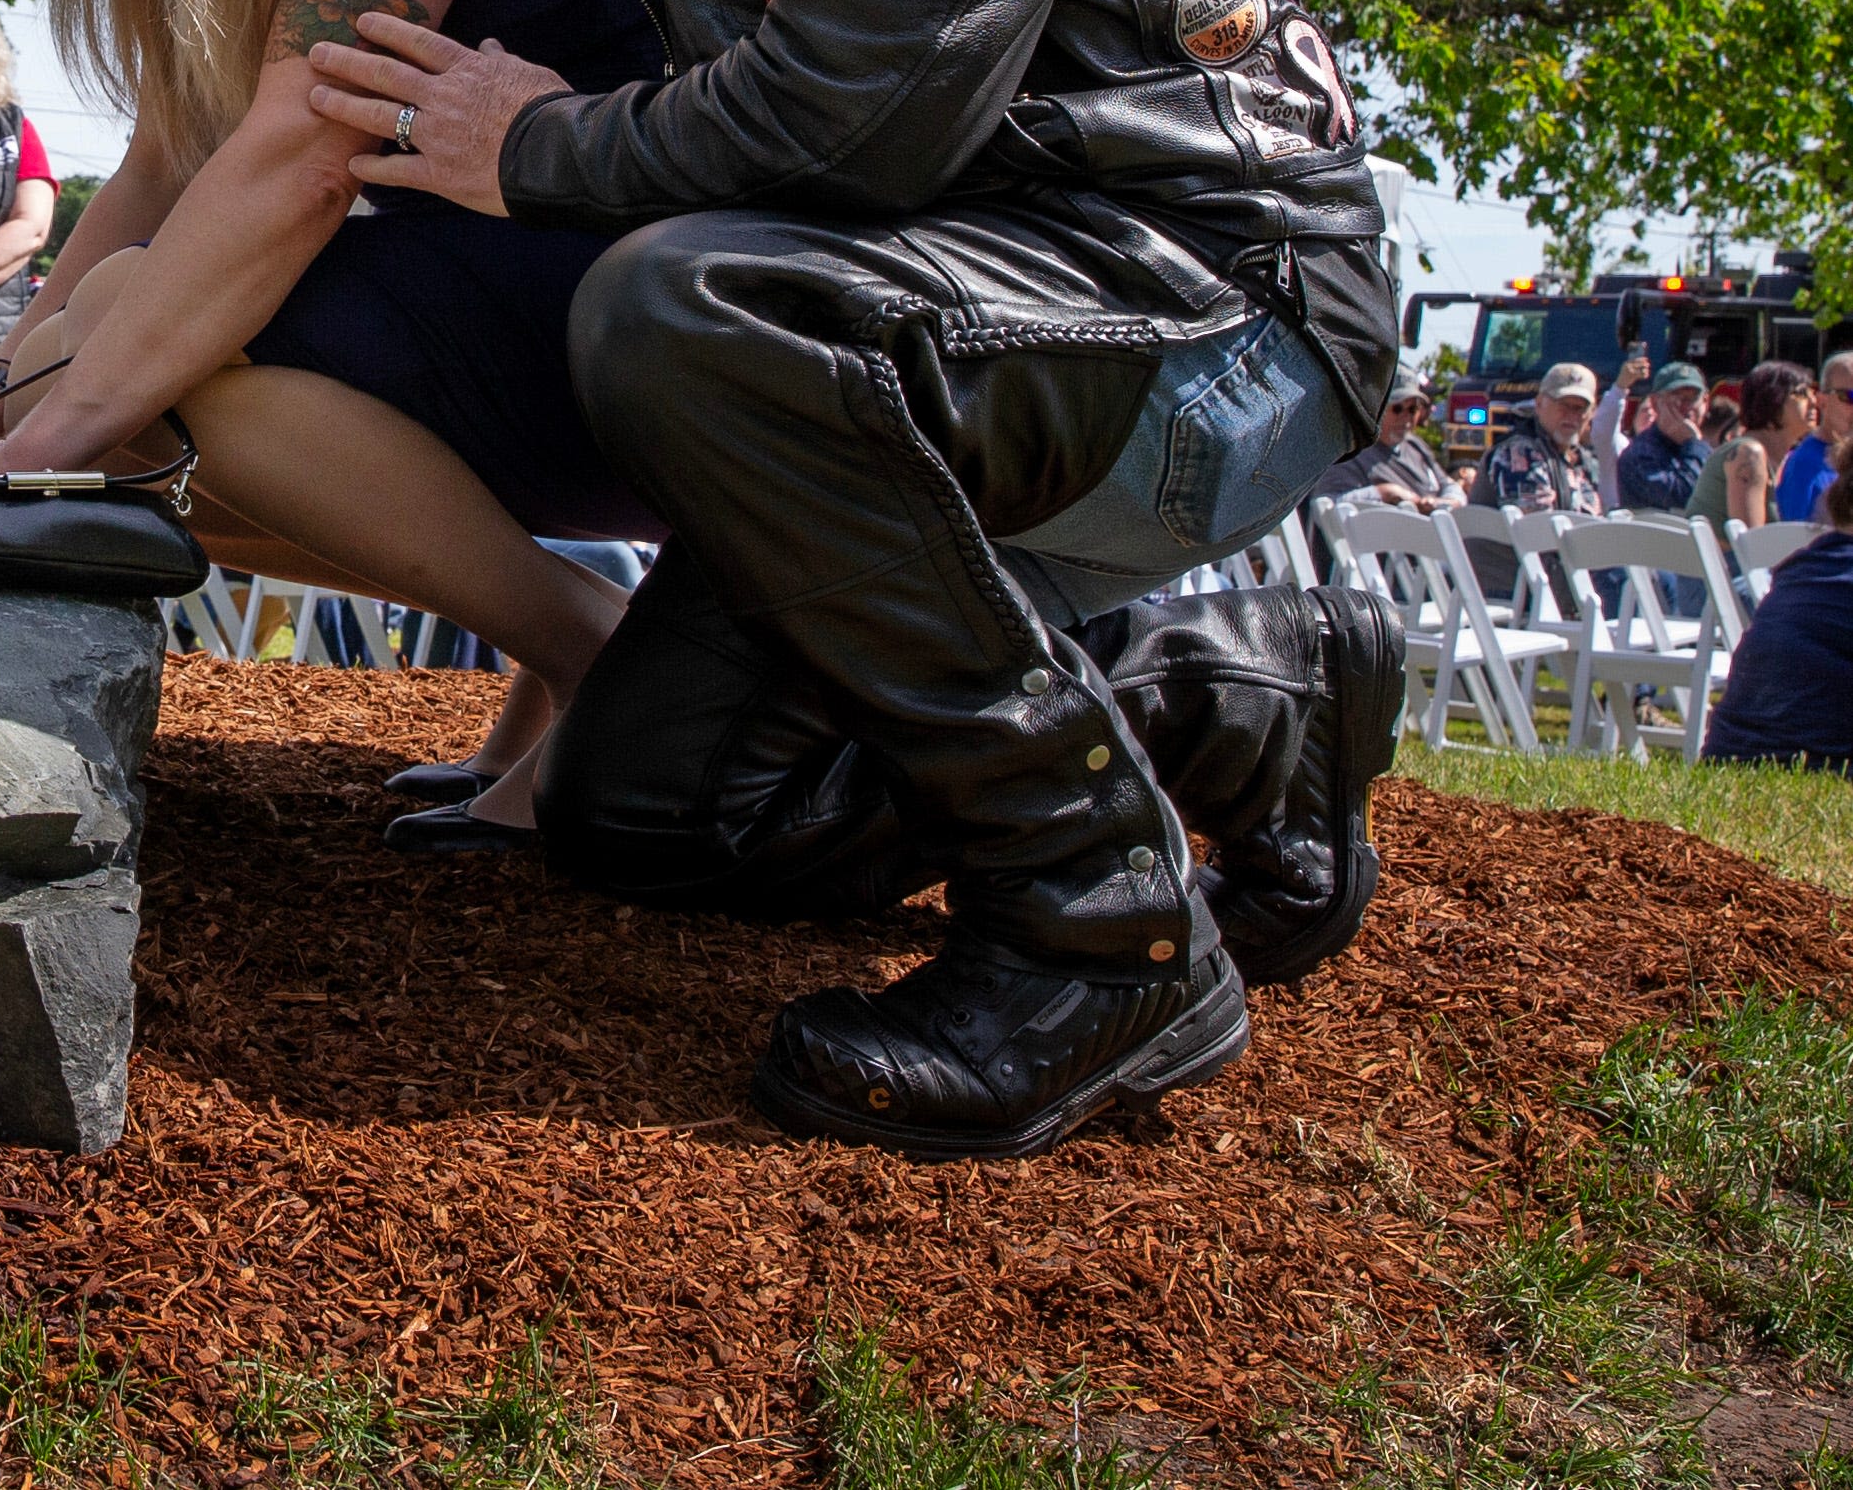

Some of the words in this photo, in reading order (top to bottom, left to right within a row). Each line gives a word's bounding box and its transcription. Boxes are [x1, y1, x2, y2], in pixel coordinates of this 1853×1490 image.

[1189, 38, 1221, 58] CURVES
[1223, 46, 1234, 56] IN
[1241, 11, 1254, 41] MILES
[1212, 19, 1239, 47] 318
[1241, 104, 1307, 129] SALOON
